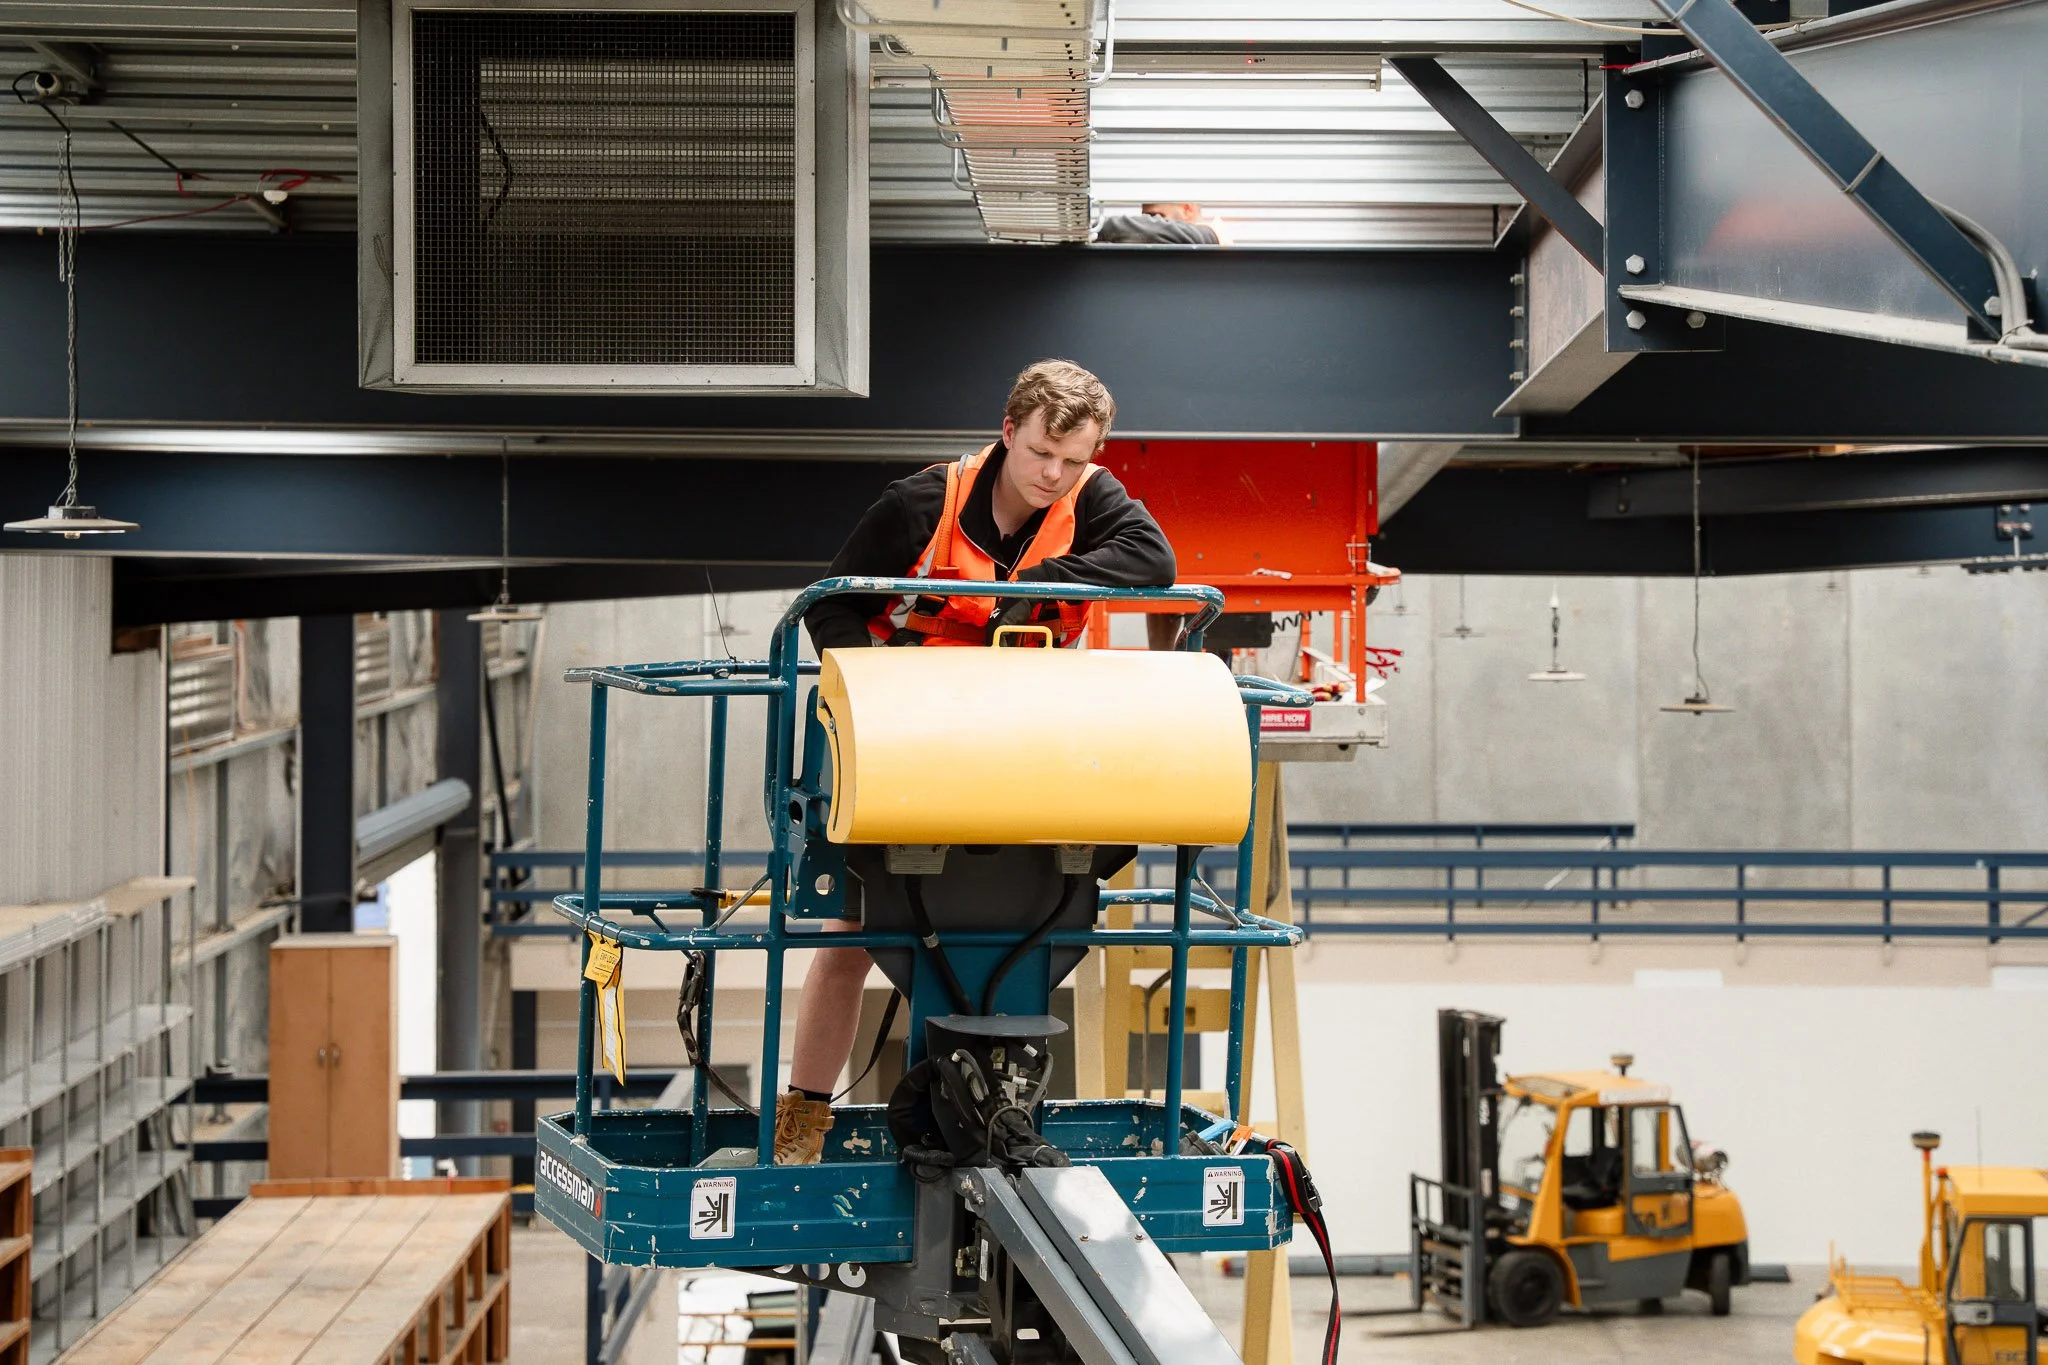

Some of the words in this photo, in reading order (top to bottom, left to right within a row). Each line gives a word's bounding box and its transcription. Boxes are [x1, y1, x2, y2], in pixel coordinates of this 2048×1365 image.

[1261, 713, 1283, 723] HIRE
[1284, 713, 1306, 723] NOW
[540, 1150, 595, 1212] accessman
[703, 1180, 734, 1188] WARNING
